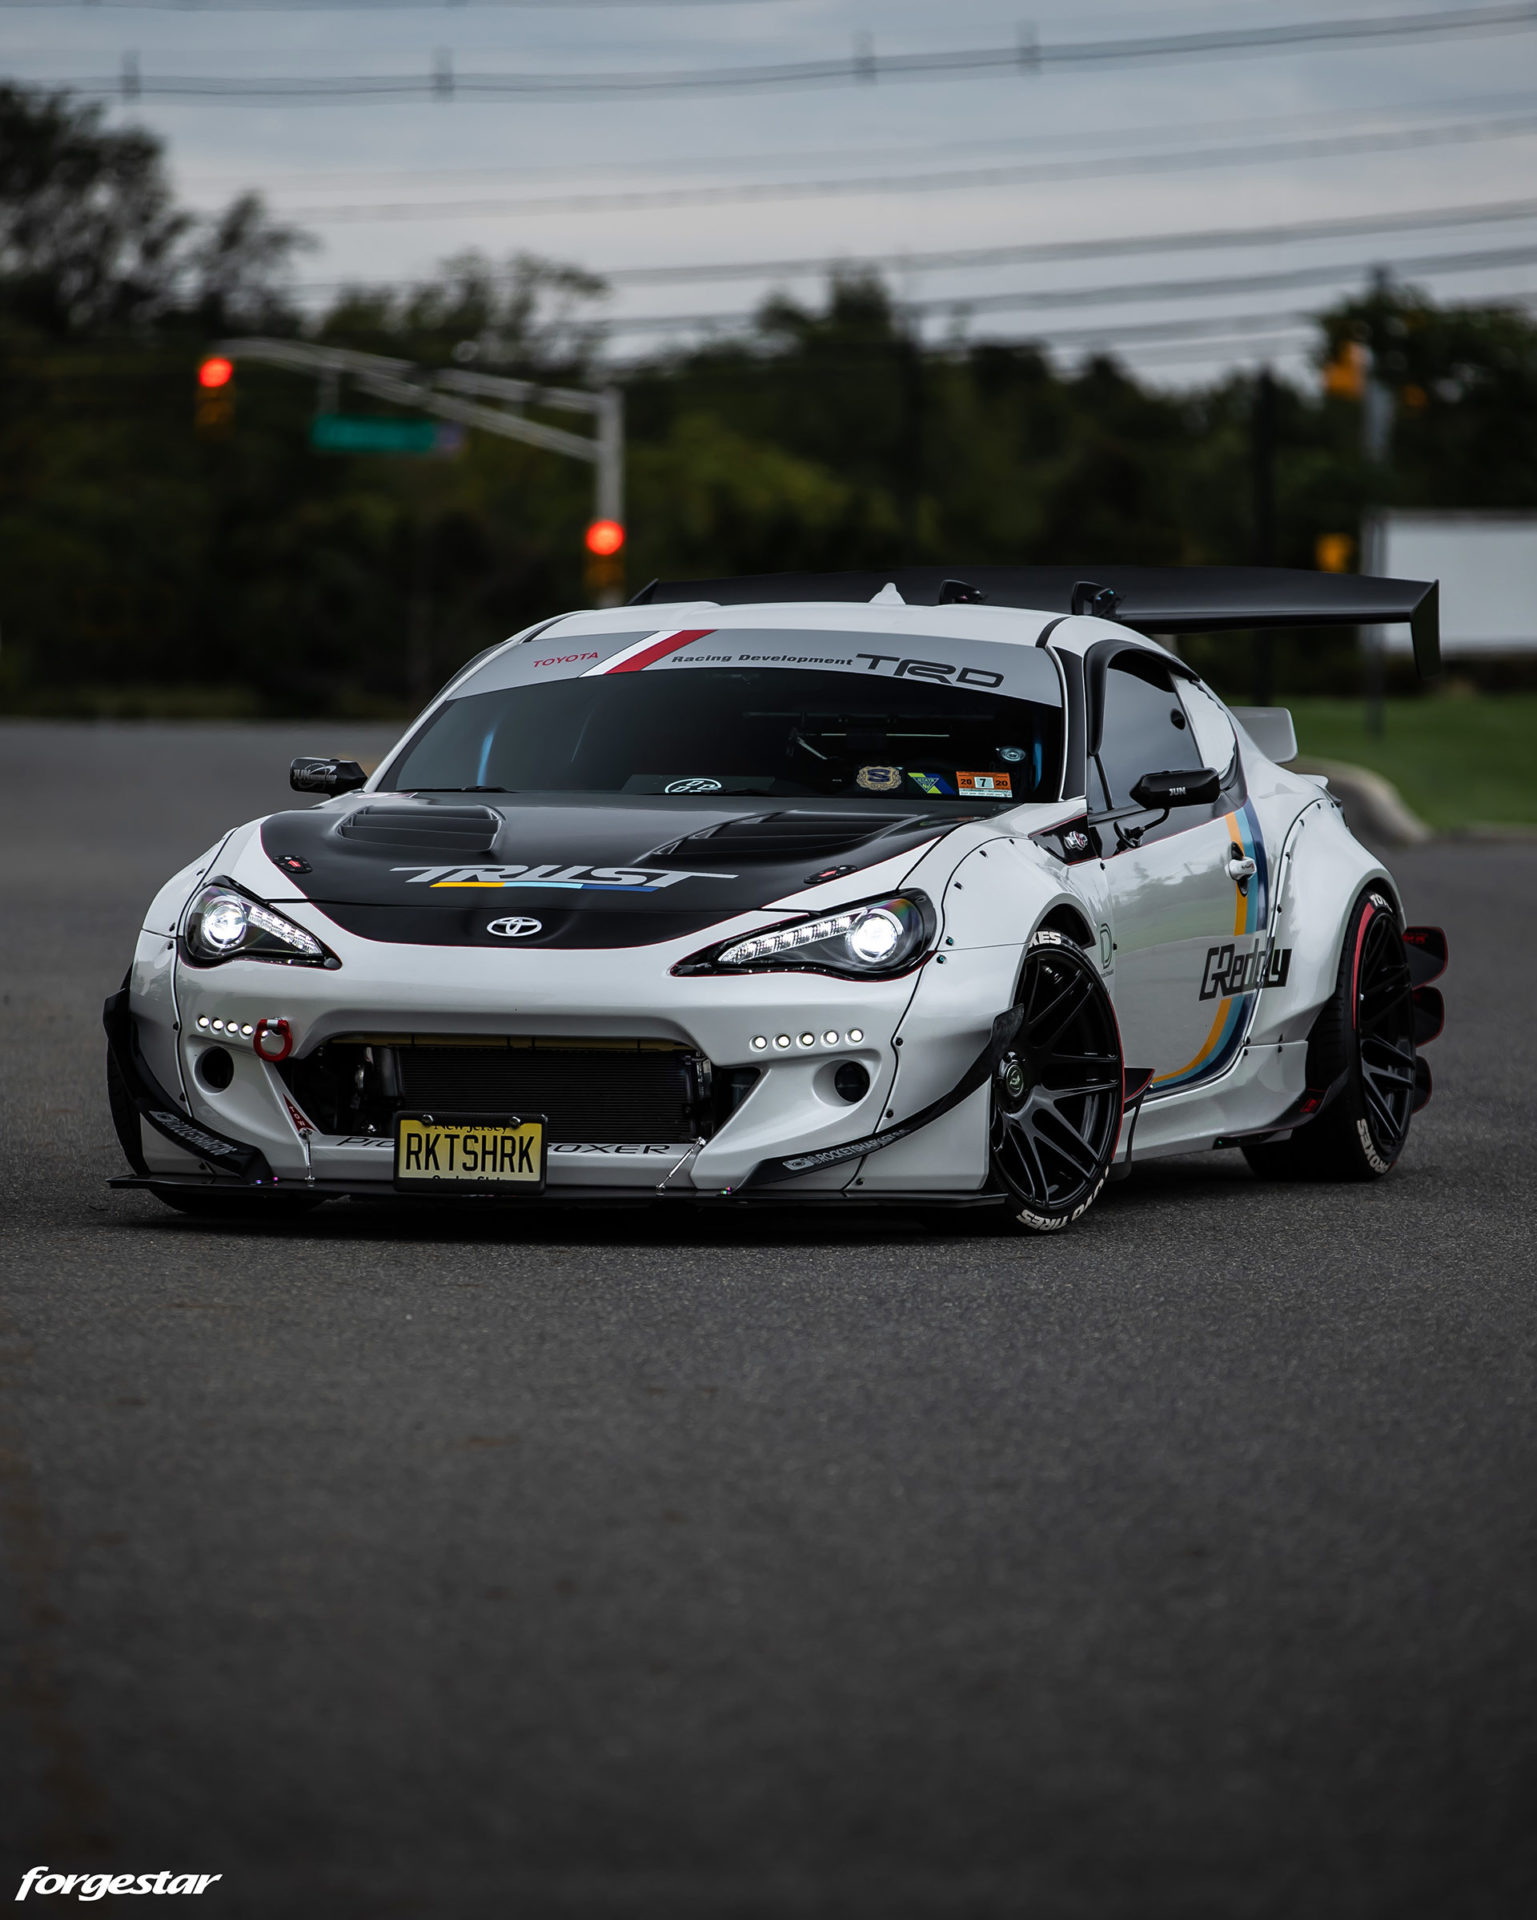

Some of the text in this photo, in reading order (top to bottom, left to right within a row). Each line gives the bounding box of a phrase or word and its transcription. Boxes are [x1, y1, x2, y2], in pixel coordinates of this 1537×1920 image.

[533, 652, 599, 668] TOYOTA
[672, 653, 1005, 688] Racing Development TRD
[979, 778, 986, 787] 7
[389, 865, 740, 888] TRUST
[406, 1133, 535, 1173] RKTSHRK
[1015, 1208, 1069, 1231] TIRES
